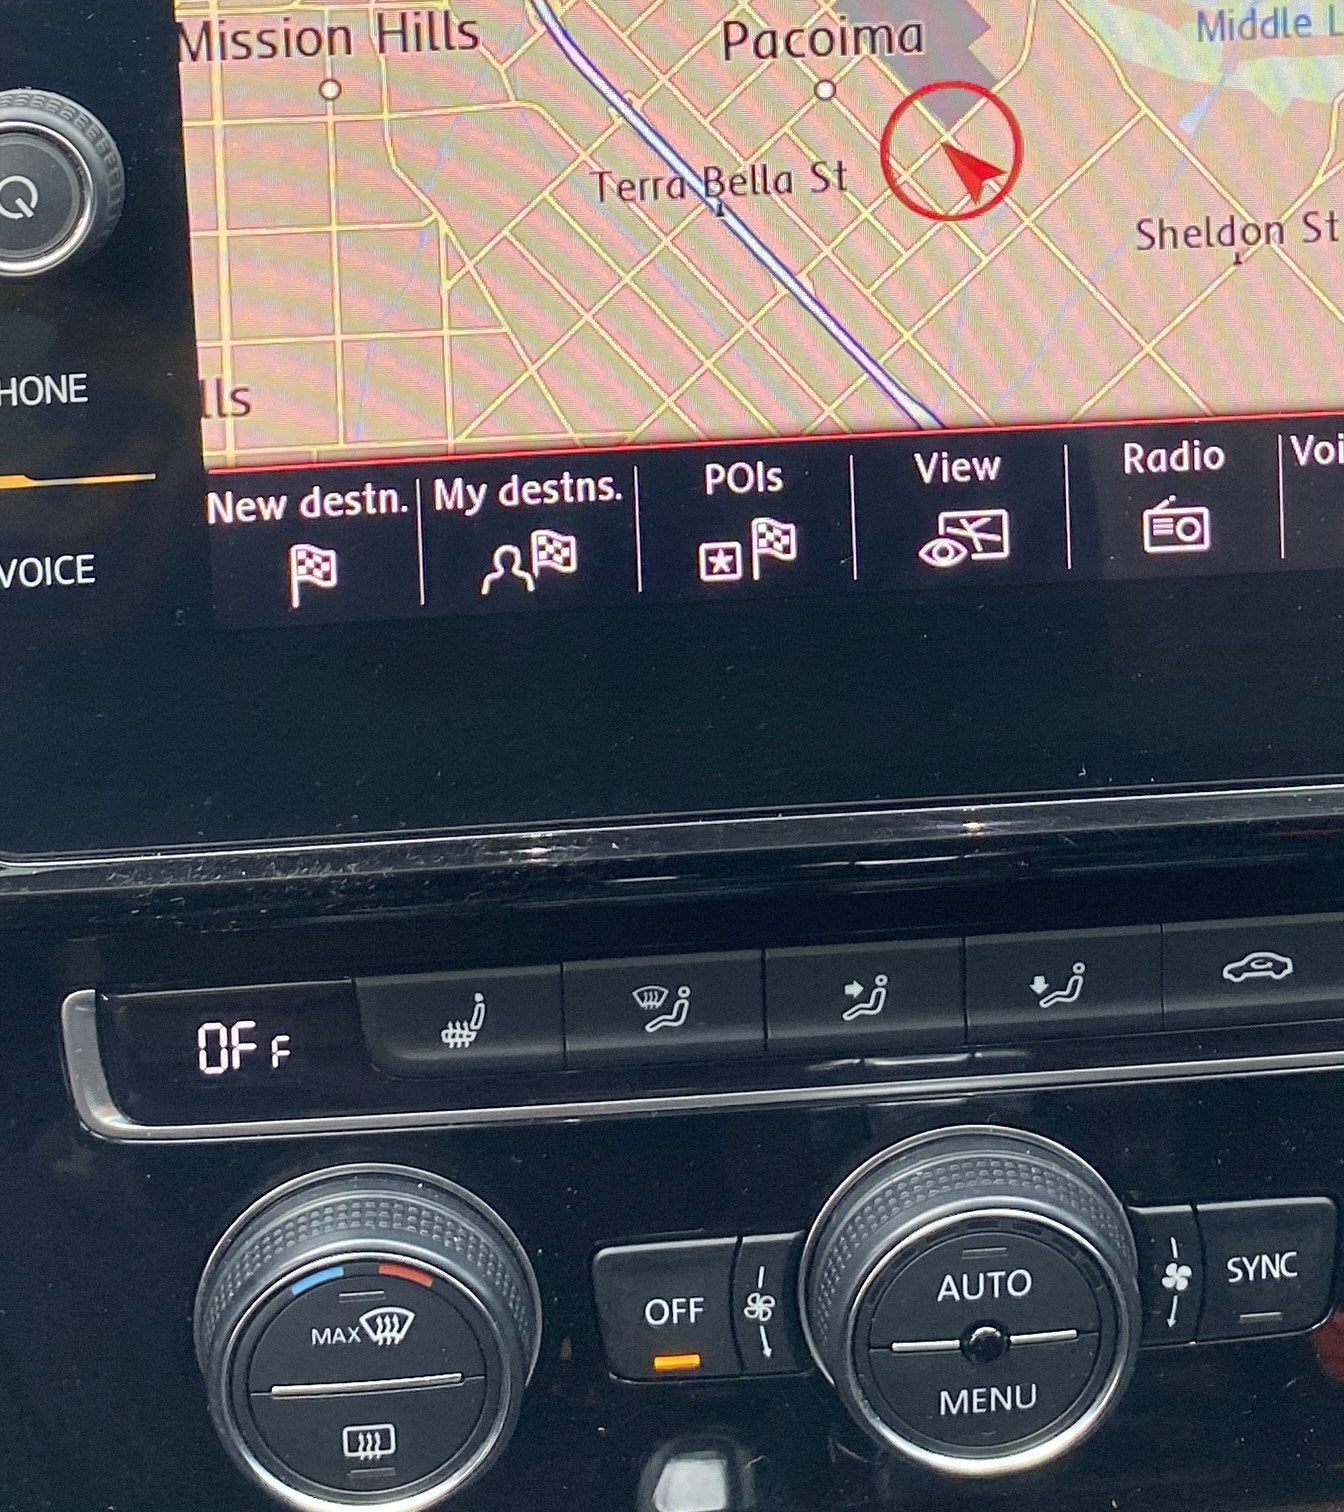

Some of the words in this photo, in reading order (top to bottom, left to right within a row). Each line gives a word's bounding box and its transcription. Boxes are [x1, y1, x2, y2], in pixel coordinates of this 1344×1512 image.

[178, 18, 352, 62] Mission
[377, 12, 479, 53] Hills
[723, 15, 924, 61] Pacoima
[1196, 7, 1314, 44] Middle
[590, 171, 687, 202] Terra
[703, 166, 794, 197] Bella
[811, 160, 847, 192] St
[1136, 217, 1285, 251] Sheldon
[1303, 212, 1339, 243] St
[915, 452, 1002, 484] View
[1124, 440, 1226, 474] Radio
[434, 478, 488, 516] My
[499, 472, 623, 507] destns.
[706, 461, 784, 495] POIs
[207, 490, 288, 524] New
[300, 484, 408, 520] destn.
[1227, 1251, 1298, 1283] SYNC
[937, 1269, 1032, 1302] AUTO
[644, 1297, 705, 1326] OFF
[311, 1326, 361, 1346] MAX
[939, 1384, 1038, 1415] MENU
